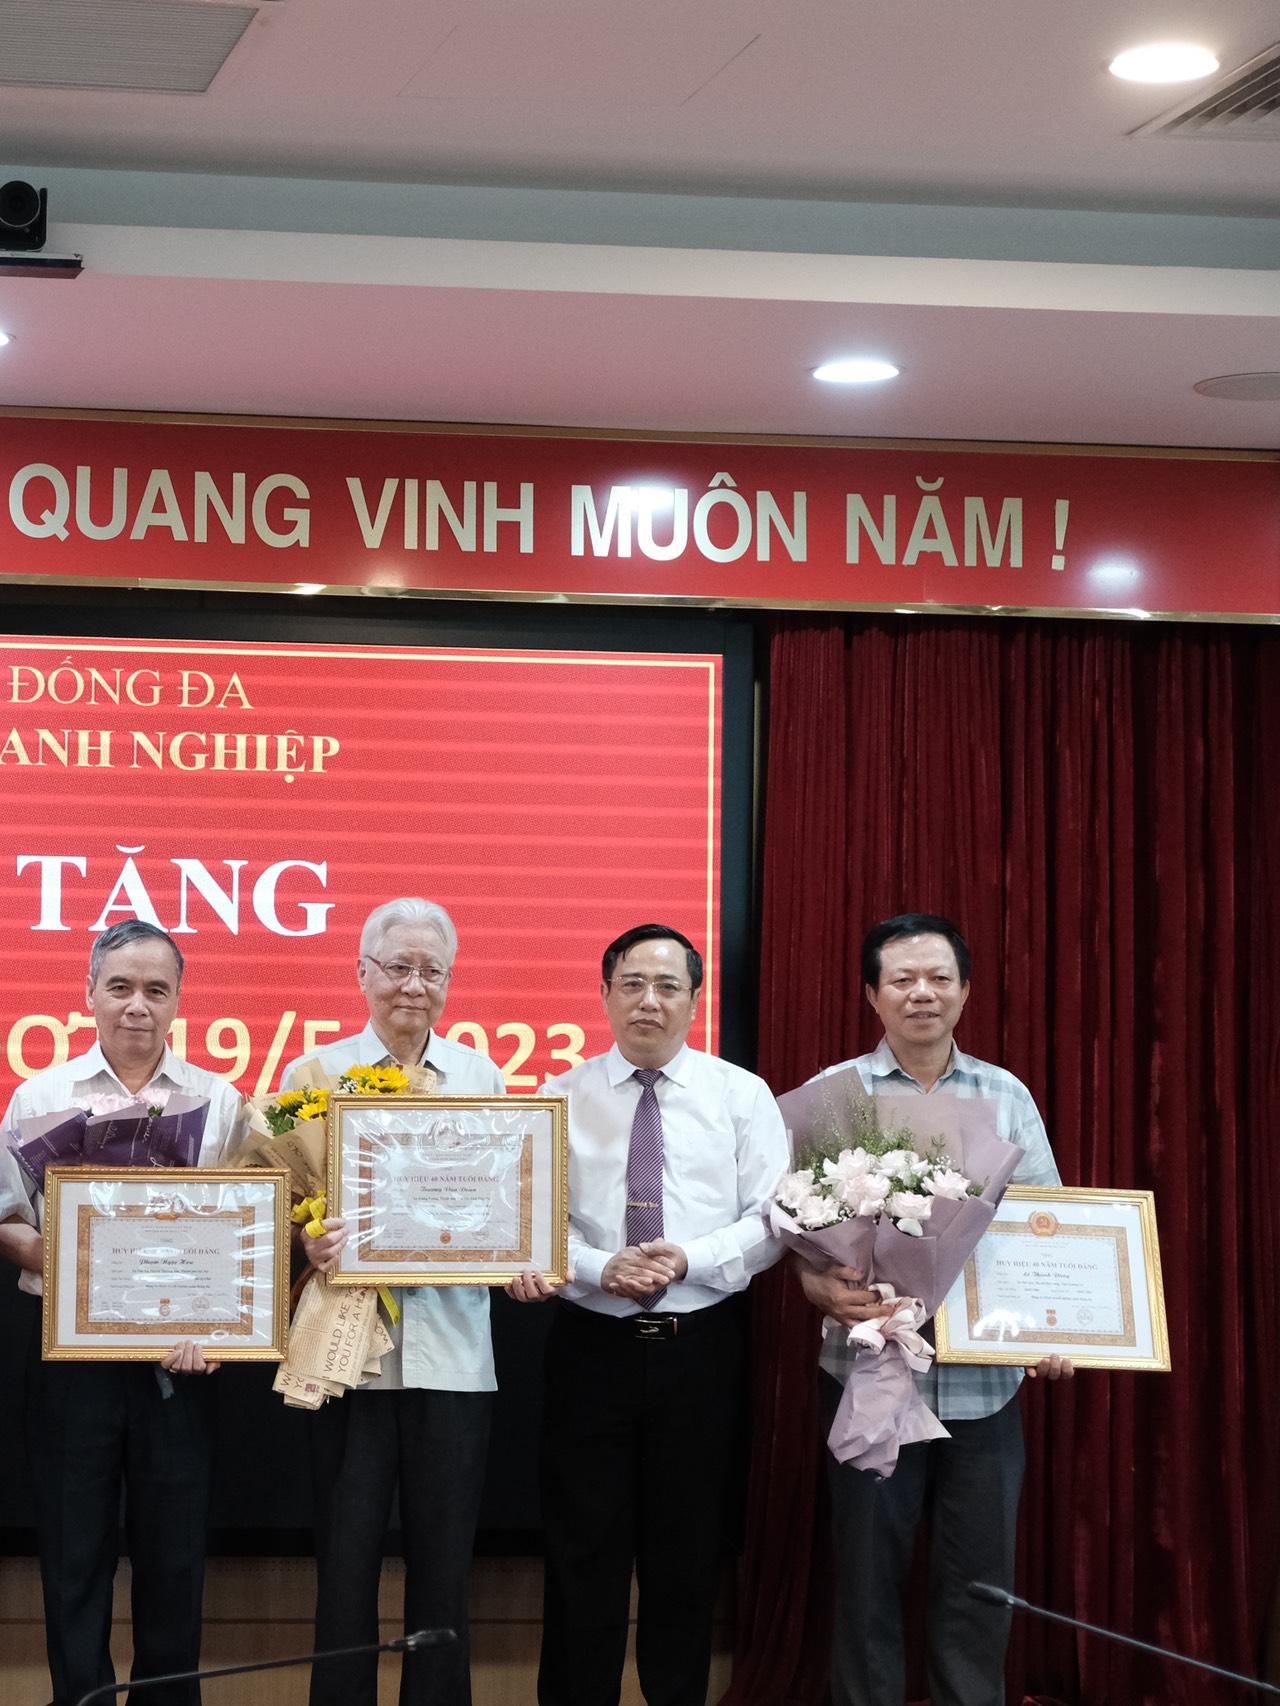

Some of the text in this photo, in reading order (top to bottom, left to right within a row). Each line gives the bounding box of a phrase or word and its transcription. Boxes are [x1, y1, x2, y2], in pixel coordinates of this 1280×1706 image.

[9, 462, 311, 549] QUANG
[346, 476, 535, 553] VINH
[570, 472, 808, 564] MUÔN
[846, 475, 1024, 568] NĂM
[7, 654, 162, 708] ĐỐNG
[178, 671, 256, 710] ĐA
[129, 728, 340, 784] NGHIỆP
[167, 1010, 586, 1098] 19/23
